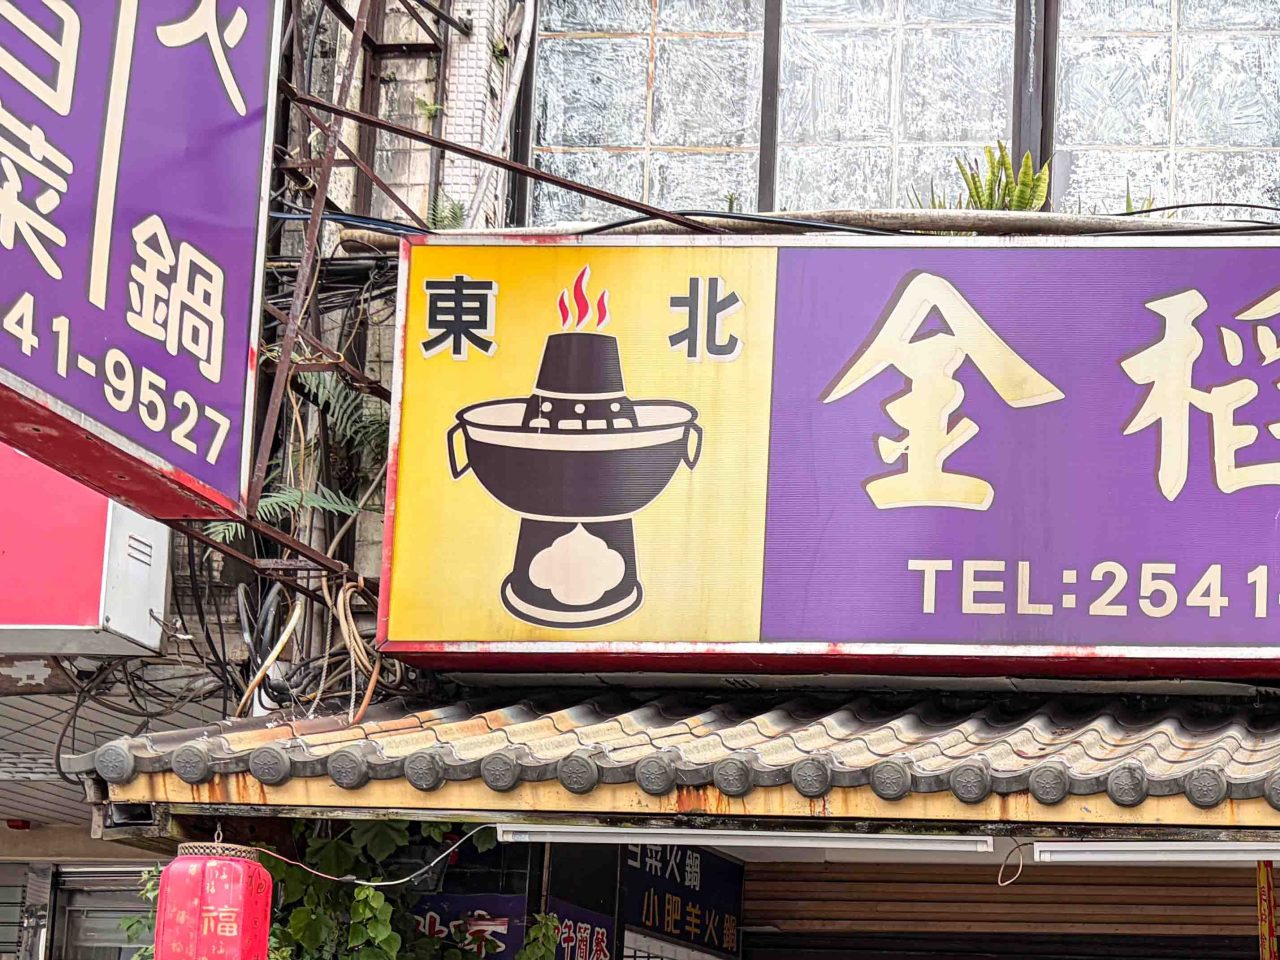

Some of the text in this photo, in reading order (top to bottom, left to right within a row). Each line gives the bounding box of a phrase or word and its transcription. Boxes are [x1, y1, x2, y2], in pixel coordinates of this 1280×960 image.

[420, 273, 744, 361] 東北
[202, 905, 241, 937] 福
[642, 887, 737, 952] 小肥羊火鍋
